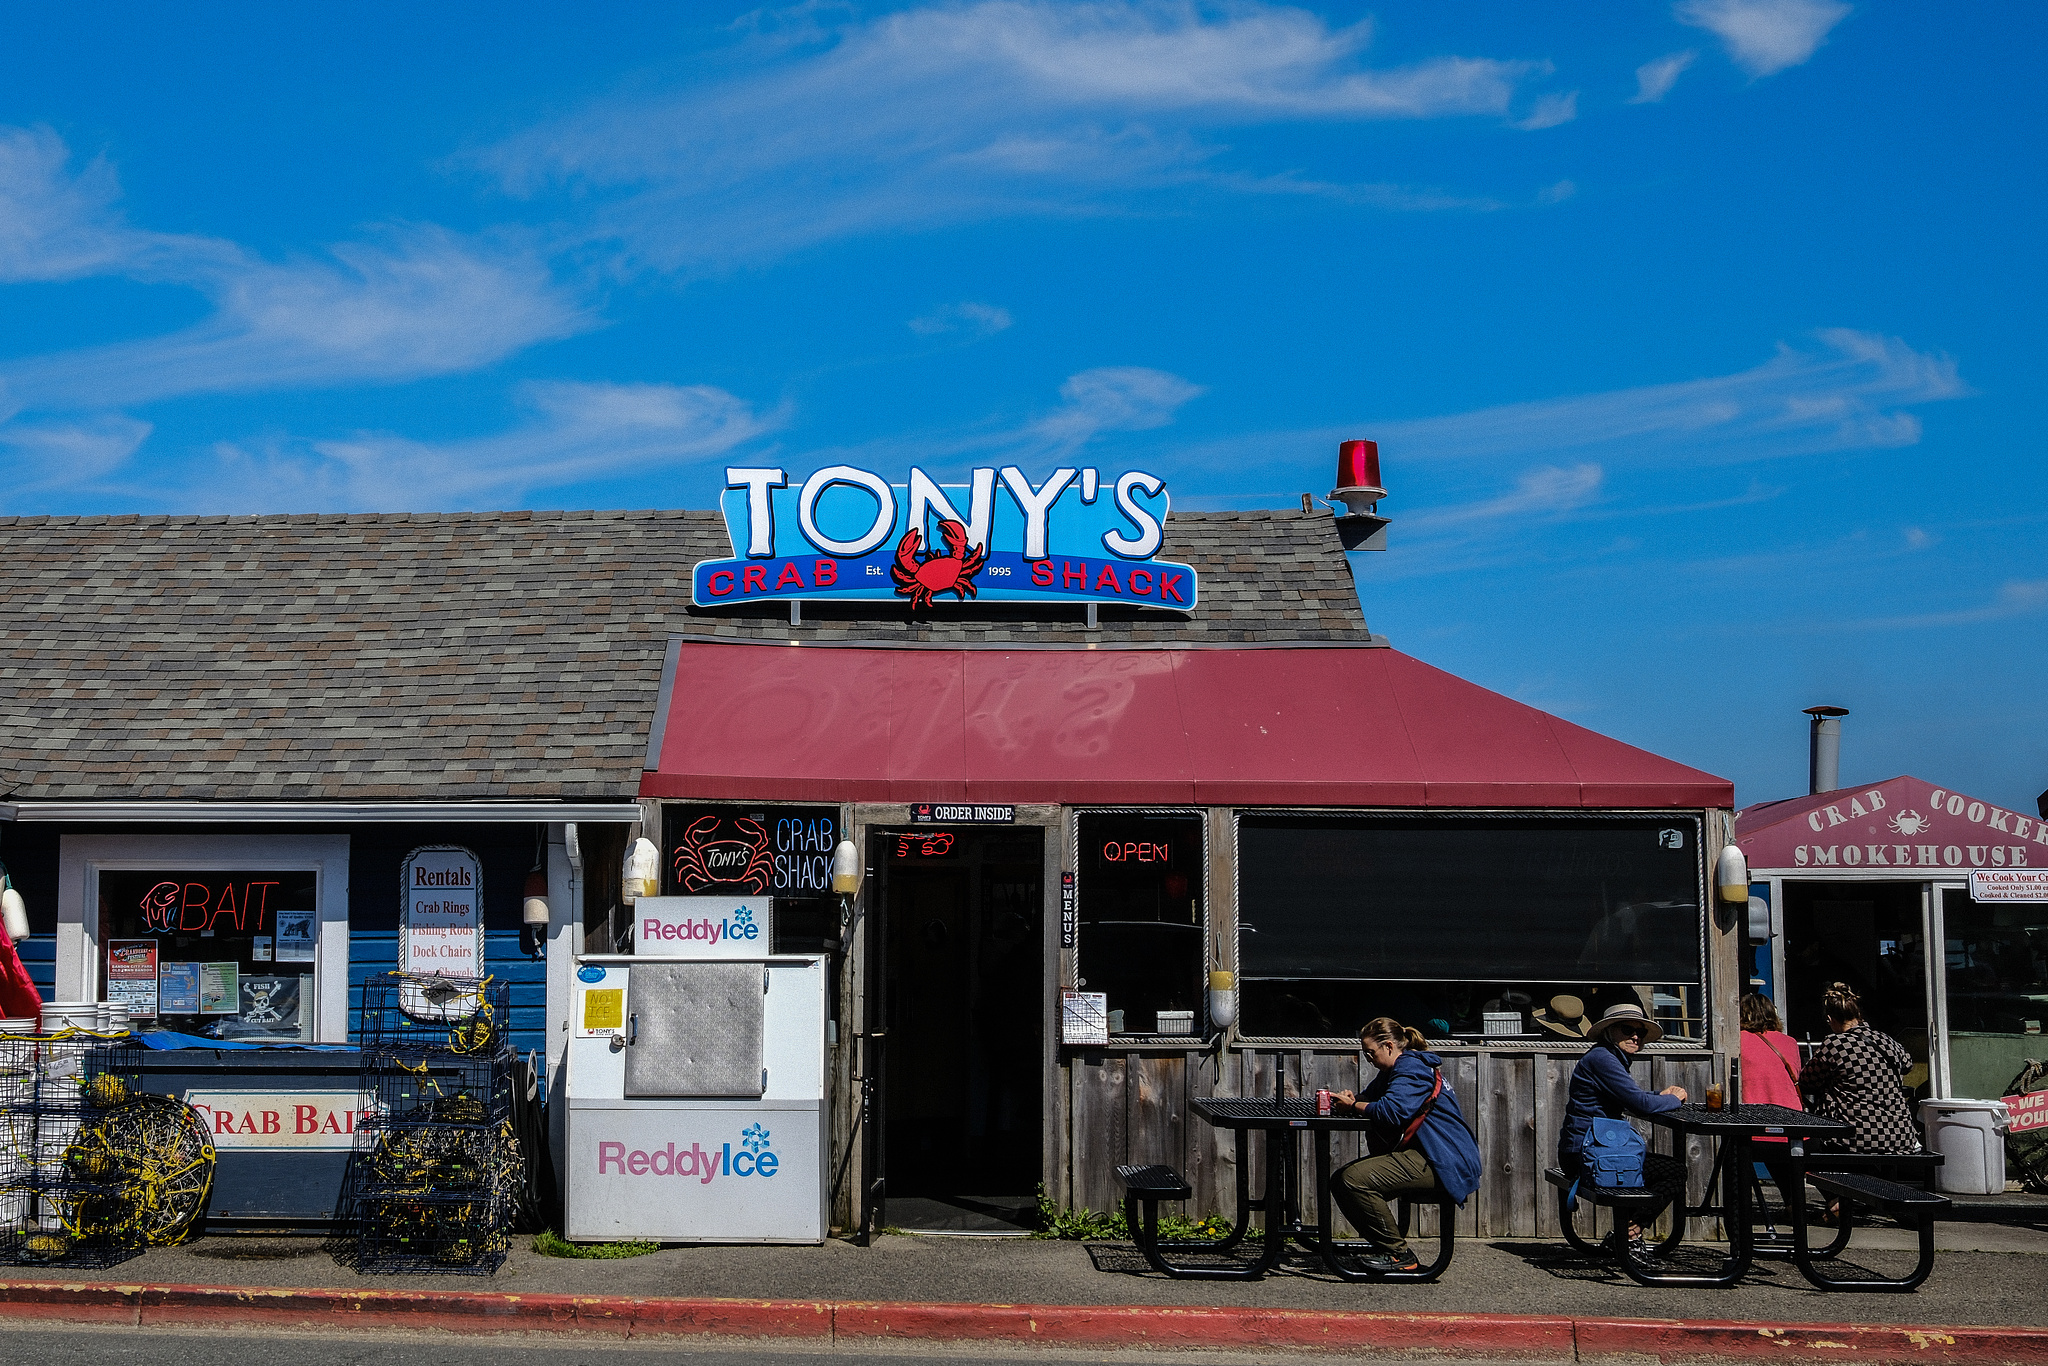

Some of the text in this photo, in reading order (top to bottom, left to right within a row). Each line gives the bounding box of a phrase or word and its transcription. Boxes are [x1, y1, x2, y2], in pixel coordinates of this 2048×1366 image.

[725, 464, 1166, 560] TONY'S
[707, 559, 1184, 602] CRAB SHACK
[865, 565, 1011, 577] Est. 1995
[935, 806, 1012, 820] ORDER INSIDE
[1807, 789, 1887, 833] CRAB
[776, 818, 833, 852] CRAB
[707, 846, 750, 868] TONY'S
[1104, 841, 1168, 862] OPEN
[1794, 844, 2029, 868] SMOKEHOUSE
[415, 866, 471, 887] Rentals
[774, 854, 835, 890] SHACK
[1977, 873, 1990, 882] We
[1992, 873, 2014, 882] Cook
[2016, 873, 2036, 882] Your
[2010, 884, 2024, 892] Only
[180, 882, 279, 930] BAIT
[415, 900, 470, 917] Crab Rings
[1063, 889, 1073, 944] MENUS
[411, 922, 473, 939] Fishing Rods
[643, 918, 759, 945] ReddyIce
[413, 944, 472, 958] Dock Chairs
[438, 966, 474, 978] Shovels
[590, 993, 608, 1005] NO
[588, 1005, 610, 1019] ICE
[2018, 1094, 2045, 1110] WE
[2011, 1110, 2048, 1128] YOU
[599, 1141, 779, 1185] ReddyIce
